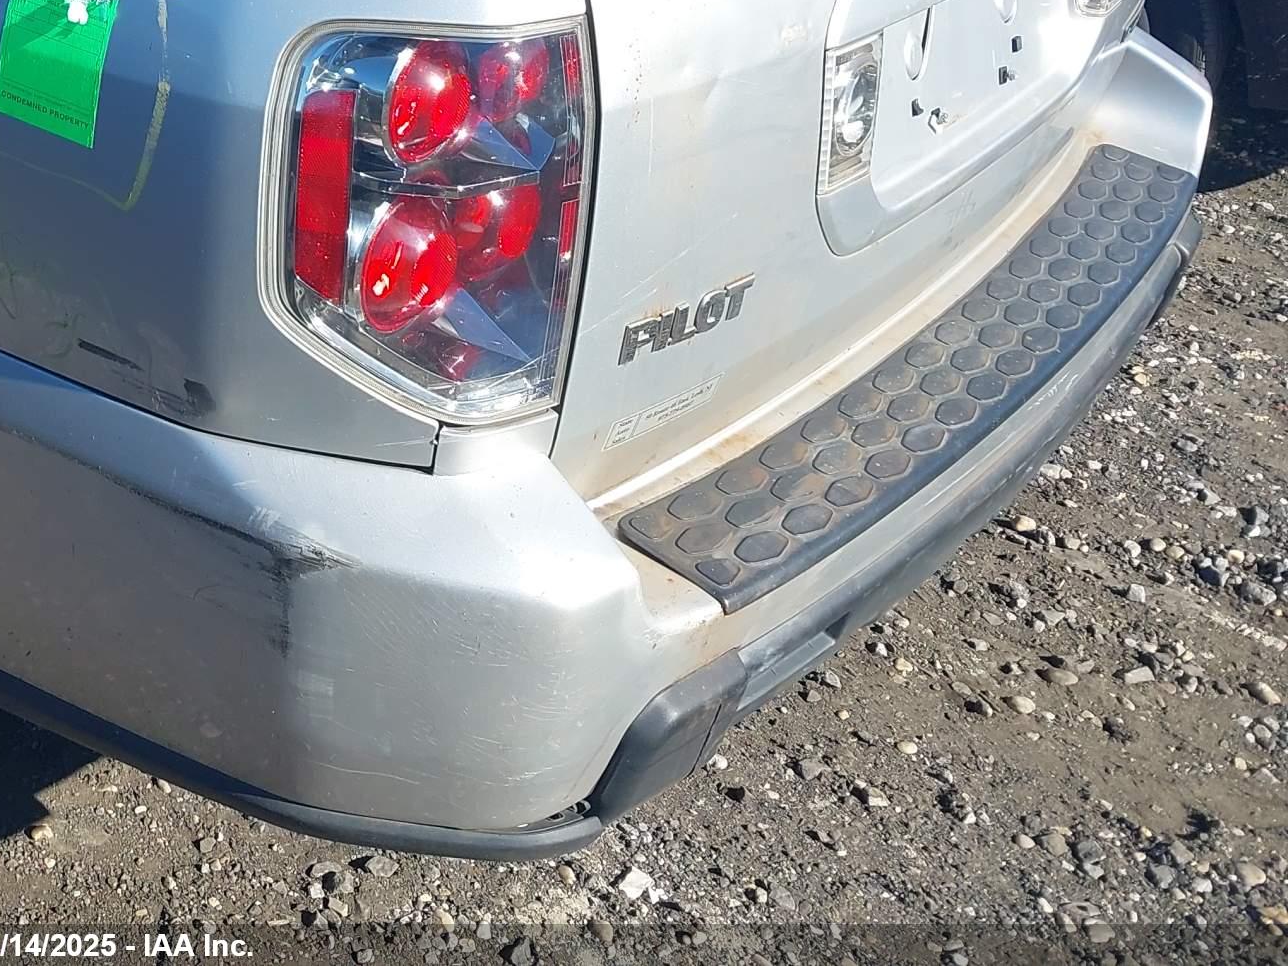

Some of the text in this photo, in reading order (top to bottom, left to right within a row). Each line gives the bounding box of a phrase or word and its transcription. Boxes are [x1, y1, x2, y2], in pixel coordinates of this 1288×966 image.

[1, 89, 48, 114] CONDEMNED
[49, 108, 89, 130] PROPERTY
[617, 272, 756, 367] PILOT
